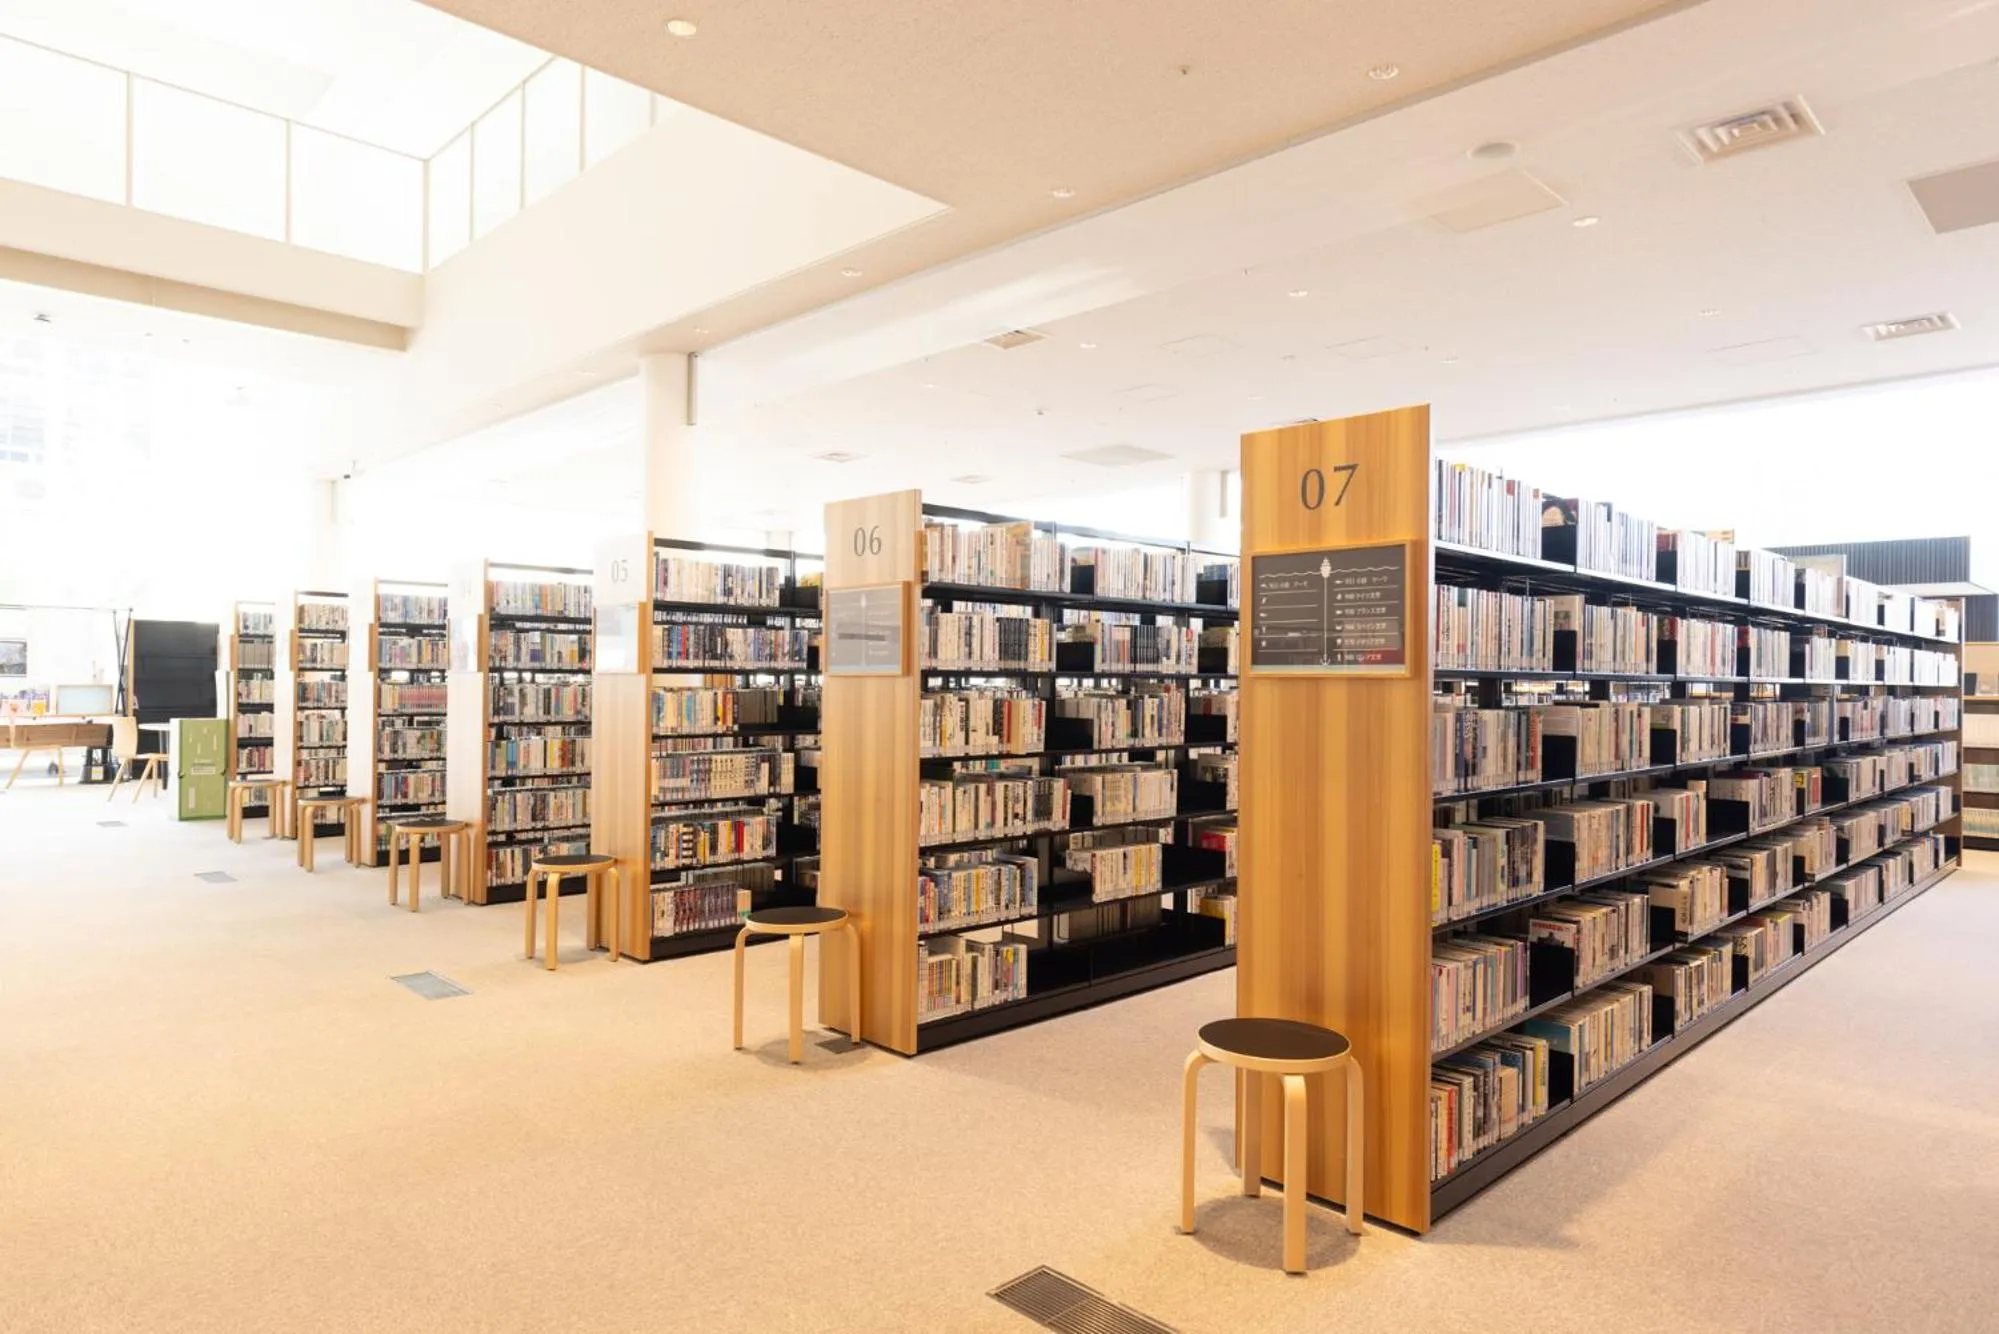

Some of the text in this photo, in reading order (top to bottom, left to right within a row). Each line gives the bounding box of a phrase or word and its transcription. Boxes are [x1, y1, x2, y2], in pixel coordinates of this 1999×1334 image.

[1301, 463, 1359, 510] 07
[854, 525, 882, 557] 06
[611, 559, 628, 584] 05
